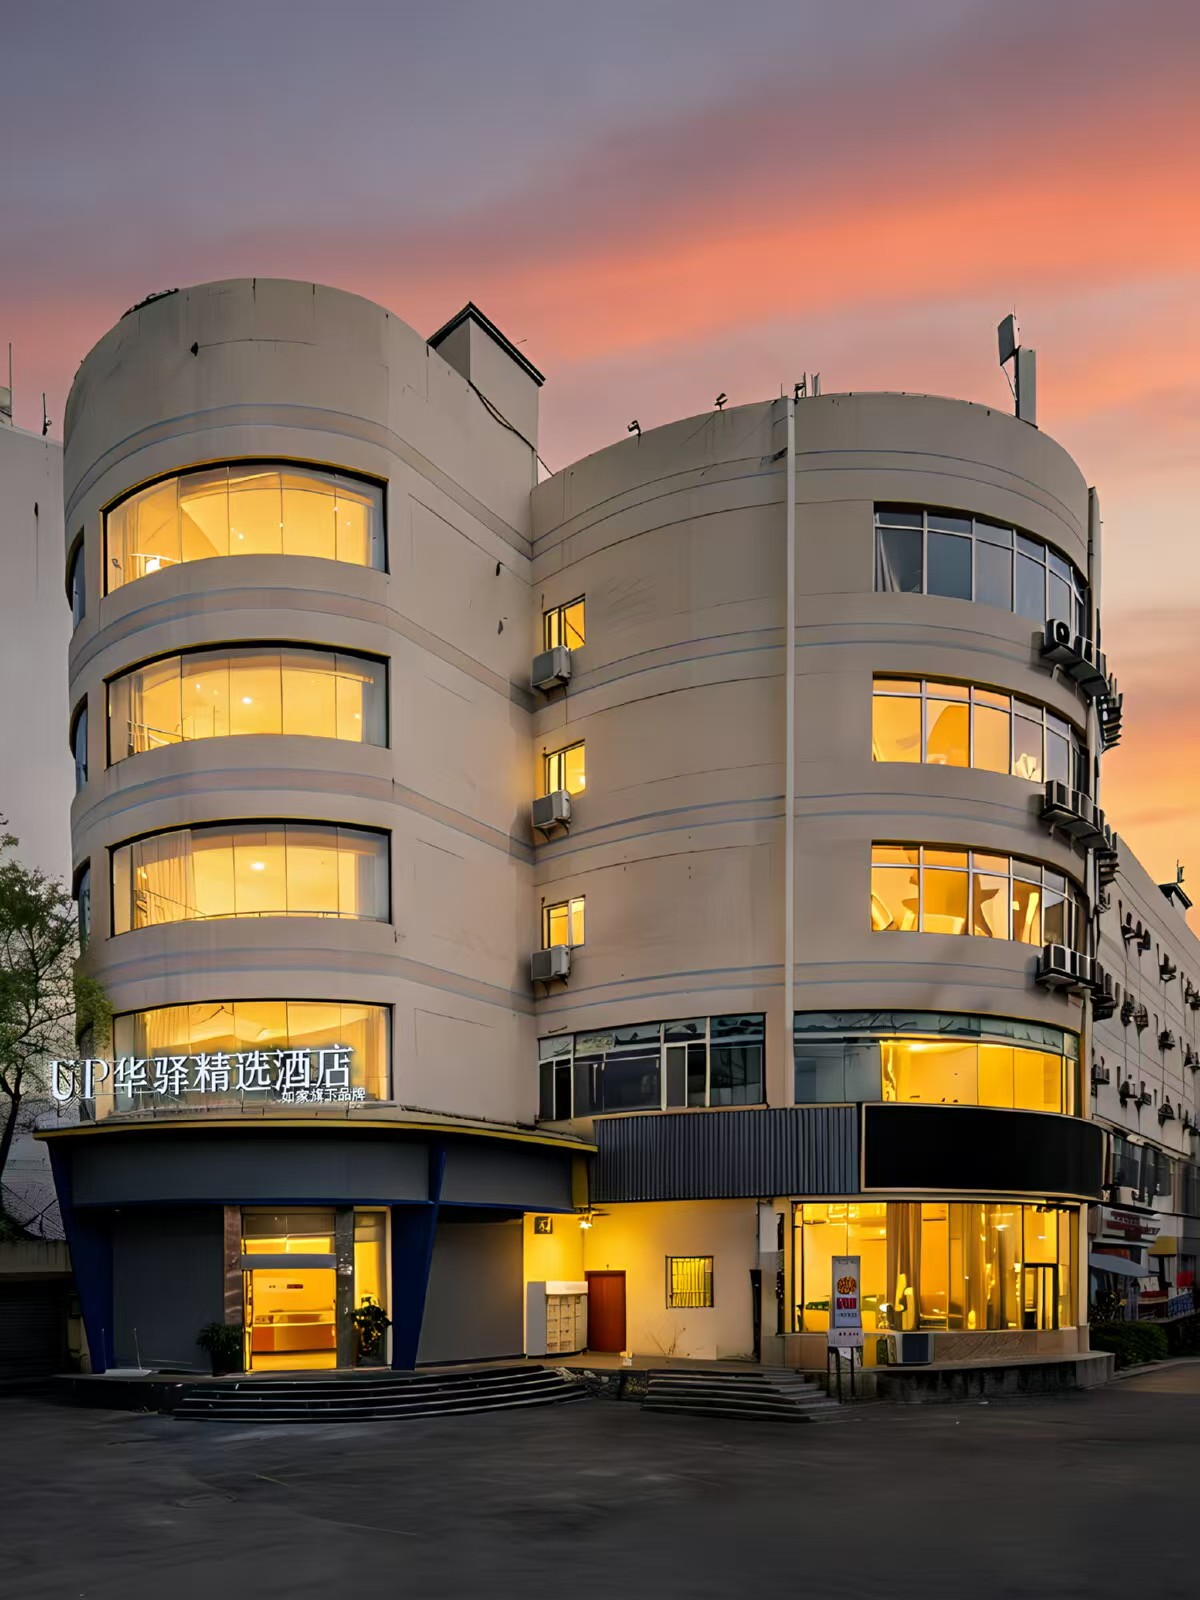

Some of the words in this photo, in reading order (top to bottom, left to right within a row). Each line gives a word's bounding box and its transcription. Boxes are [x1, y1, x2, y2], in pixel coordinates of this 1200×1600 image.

[281, 1086, 366, 1103] 如家旗下品牌
